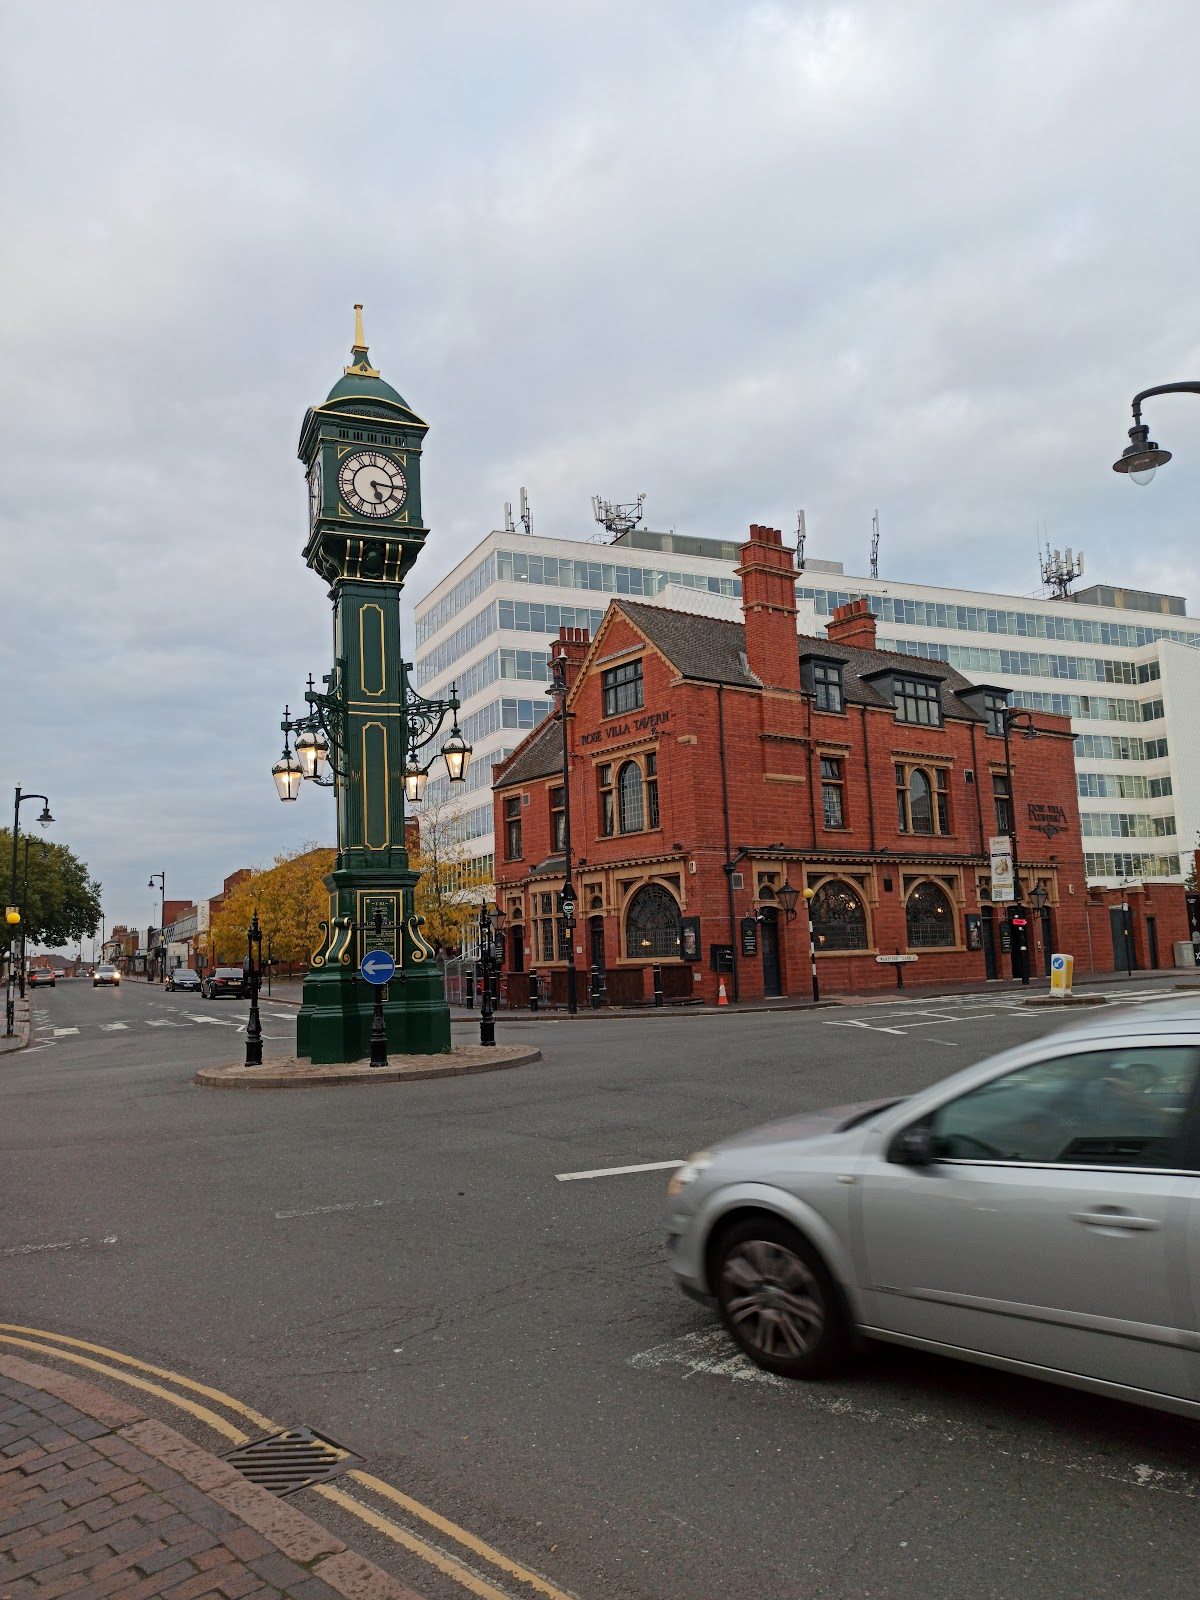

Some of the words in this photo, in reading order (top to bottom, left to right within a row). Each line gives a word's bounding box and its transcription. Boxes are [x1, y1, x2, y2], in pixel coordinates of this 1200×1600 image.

[581, 730, 602, 746] ROSE
[605, 723, 631, 739] VILLA
[634, 711, 669, 731] TAVERN
